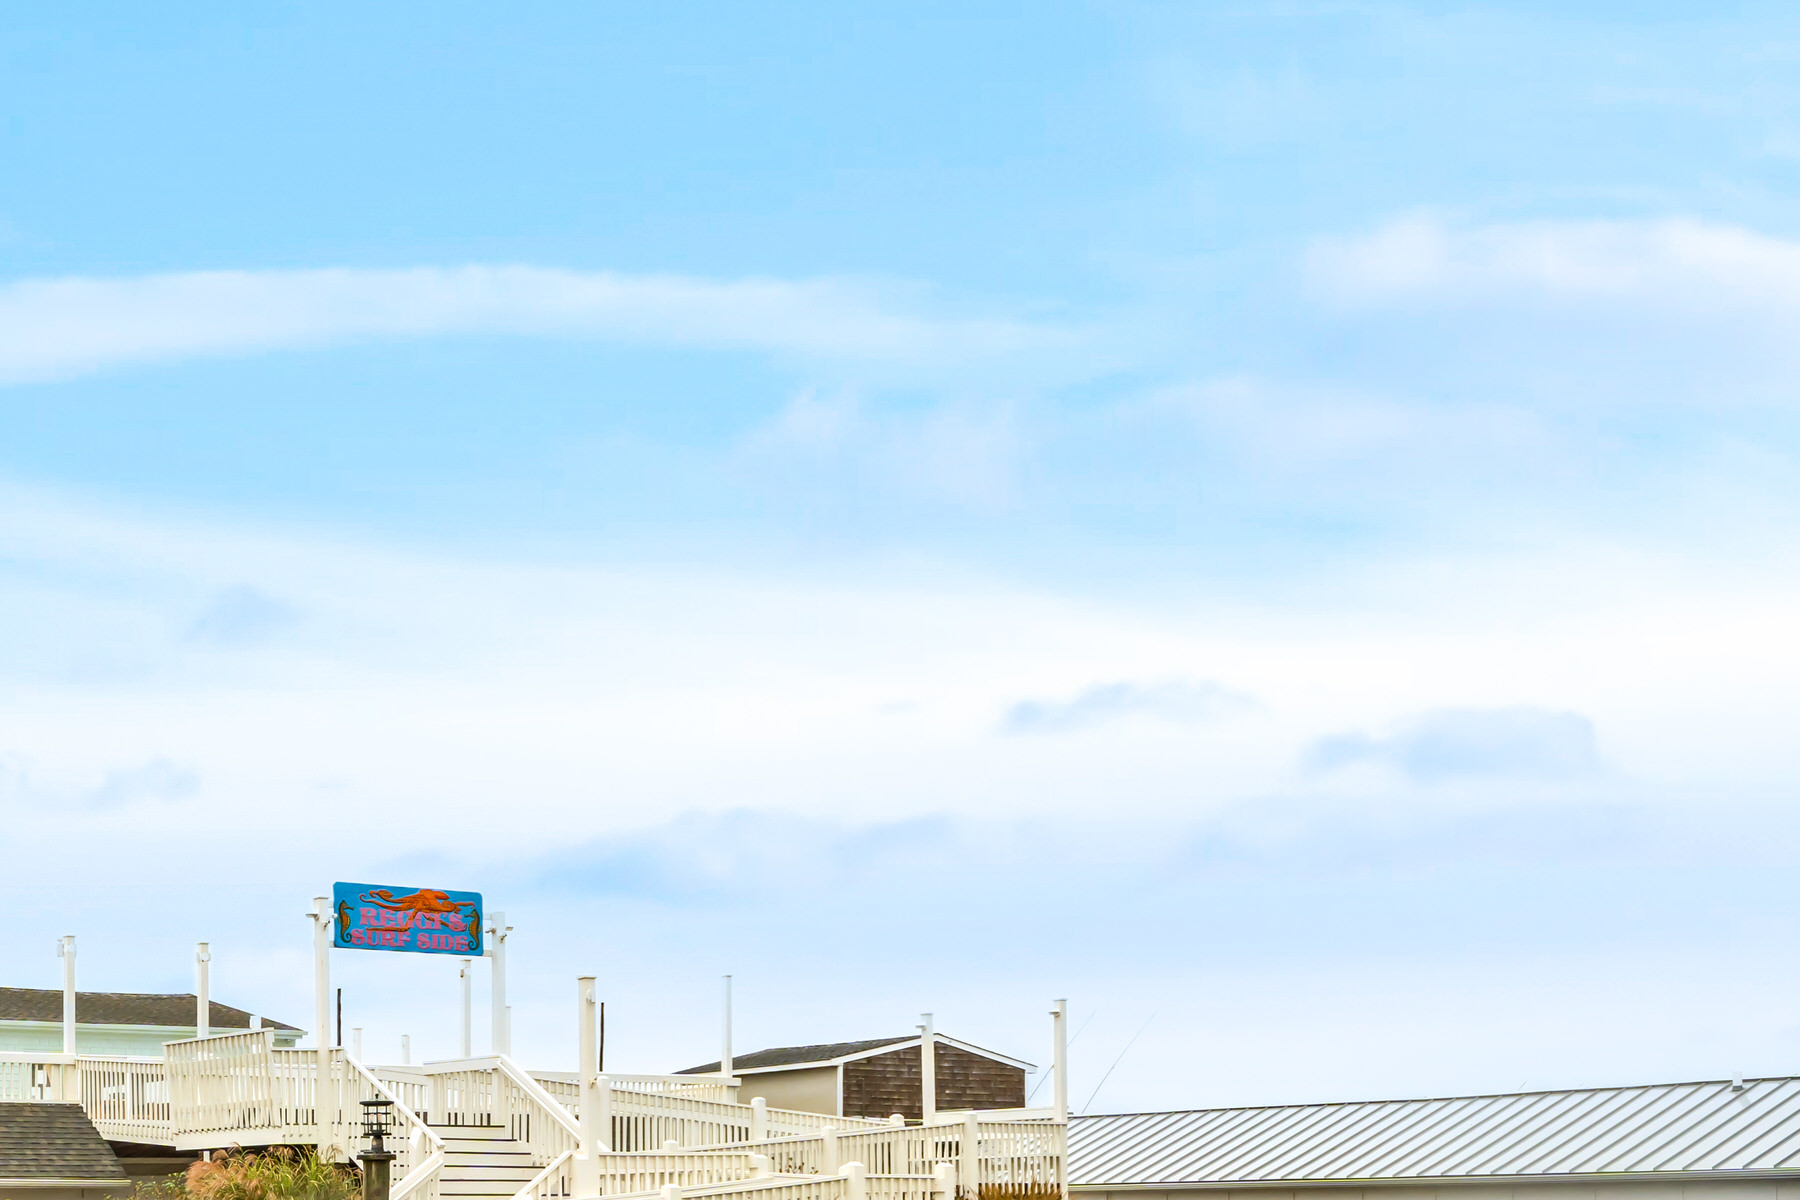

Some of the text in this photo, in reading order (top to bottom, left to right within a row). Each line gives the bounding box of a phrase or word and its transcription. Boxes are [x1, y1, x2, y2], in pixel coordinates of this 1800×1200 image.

[359, 907, 466, 932] REGGI'S
[350, 928, 471, 952] SURF SIDE
